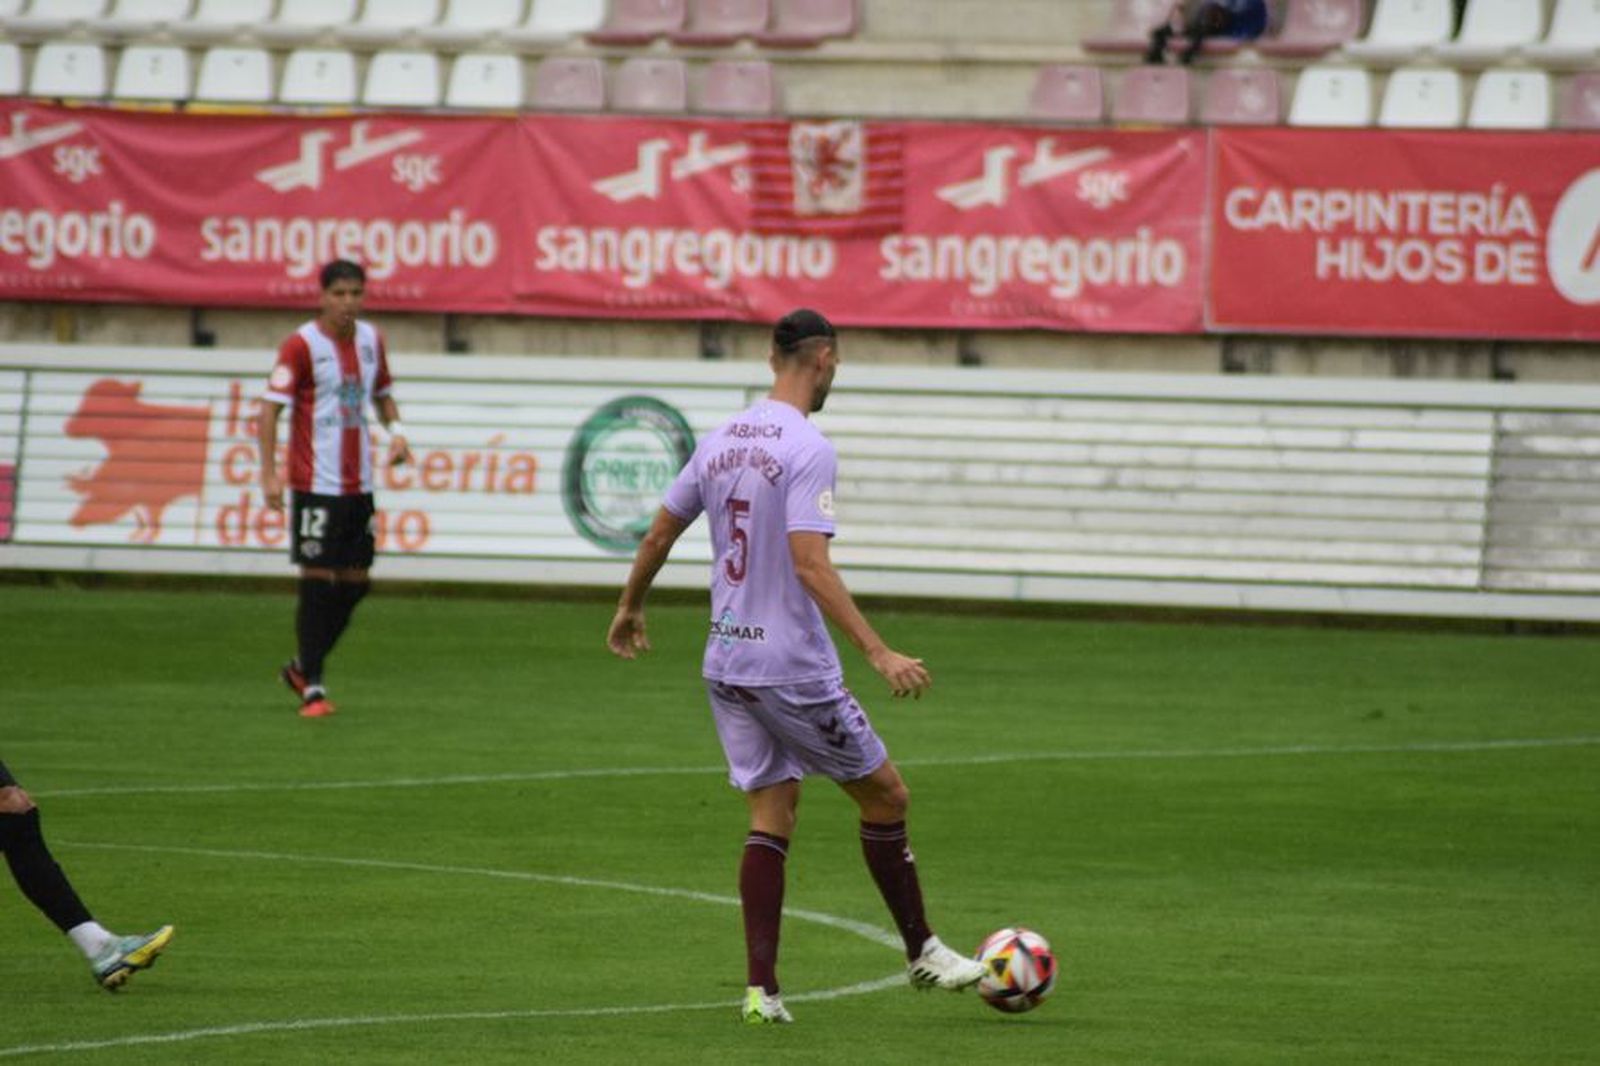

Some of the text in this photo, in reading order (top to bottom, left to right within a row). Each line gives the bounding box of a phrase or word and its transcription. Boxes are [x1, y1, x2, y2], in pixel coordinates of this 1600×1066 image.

[54, 145, 101, 182] sgc
[392, 154, 442, 191] sgc
[1076, 170, 1129, 209] sgc
[1224, 183, 1537, 237] CARPINTERÍA
[201, 209, 496, 279] sangregorio
[879, 226, 1186, 299] sangregorio
[1315, 238, 1538, 285] HIJOS DE
[216, 491, 288, 546] de
[301, 506, 328, 539] 12
[725, 497, 750, 588] 5
